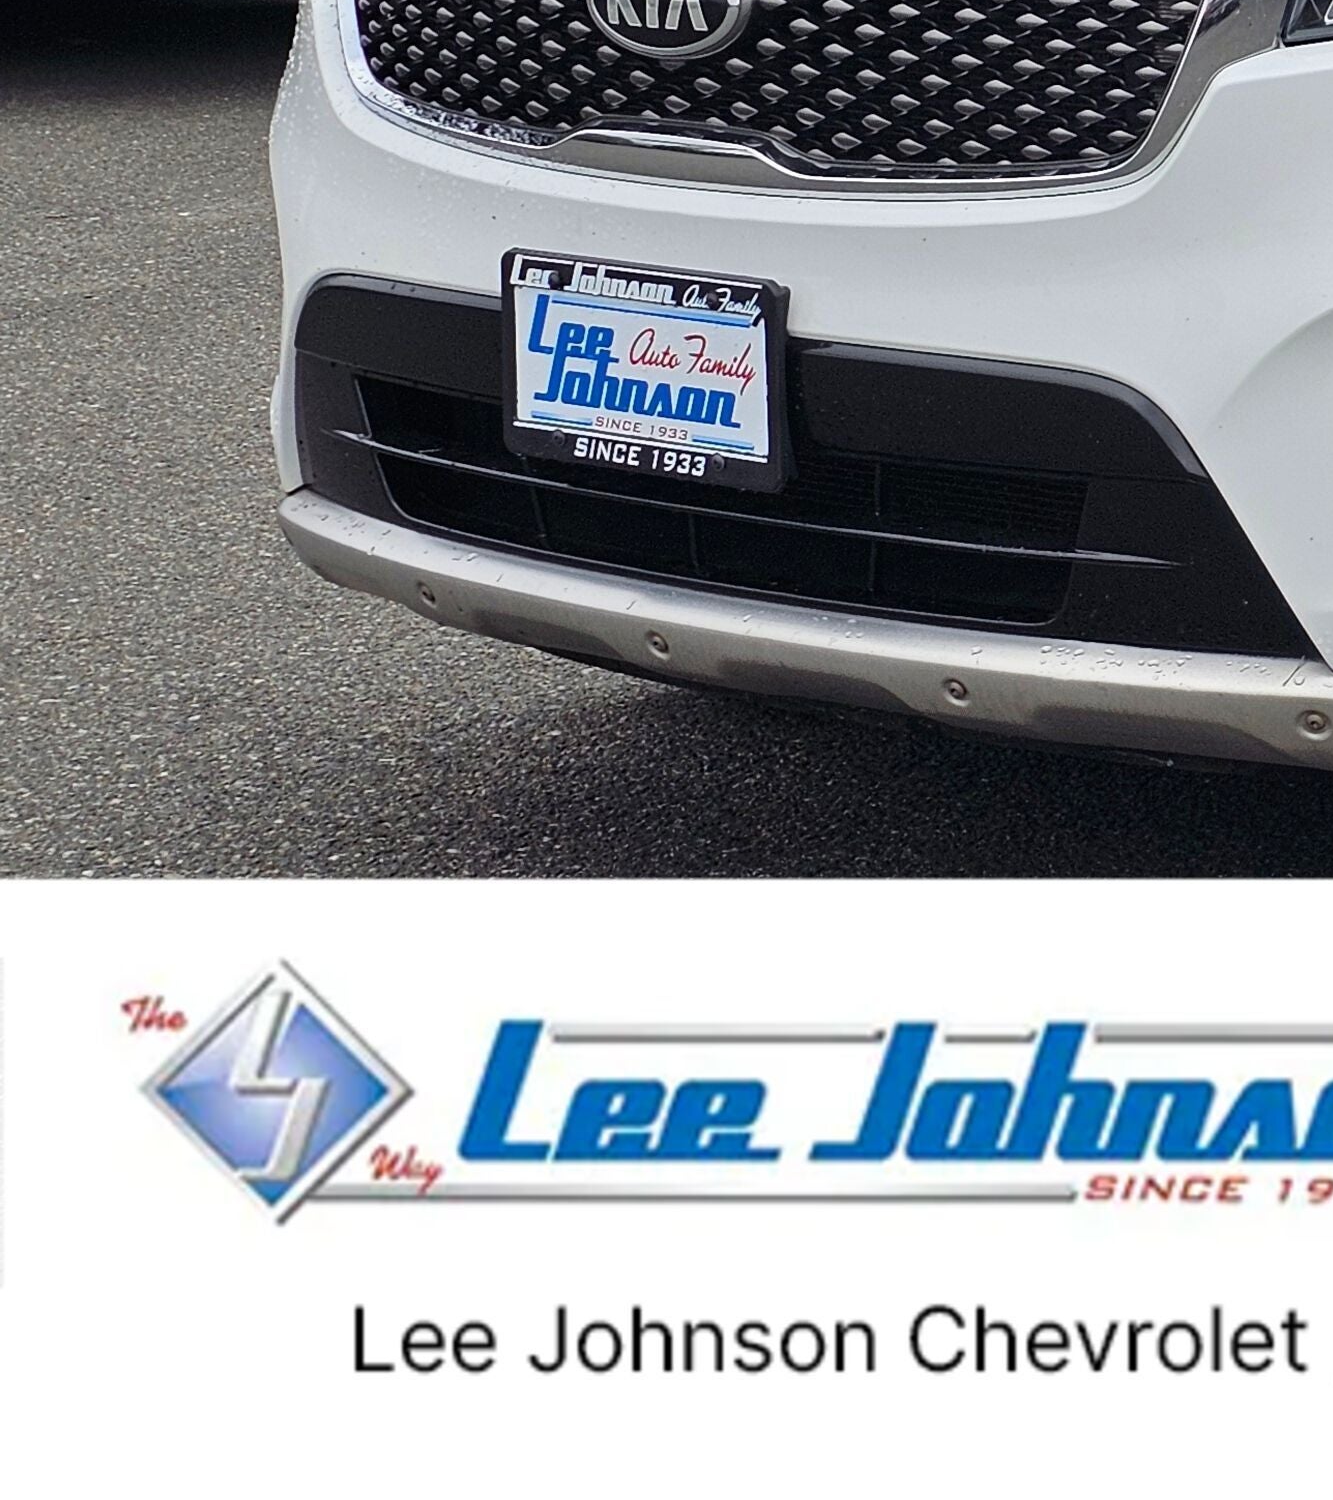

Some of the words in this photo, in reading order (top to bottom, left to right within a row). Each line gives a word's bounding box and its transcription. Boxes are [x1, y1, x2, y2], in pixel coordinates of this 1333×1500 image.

[563, 261, 677, 305] Johnson
[682, 284, 712, 309] Aut
[714, 287, 762, 326] Family
[528, 294, 620, 363] Lee
[533, 348, 742, 429] Johnson
[629, 328, 680, 369] Auto
[683, 334, 758, 396] Family
[573, 437, 642, 467] SINCE
[651, 449, 707, 477] 1933
[594, 416, 642, 433] SINCE
[649, 424, 689, 441] 1933
